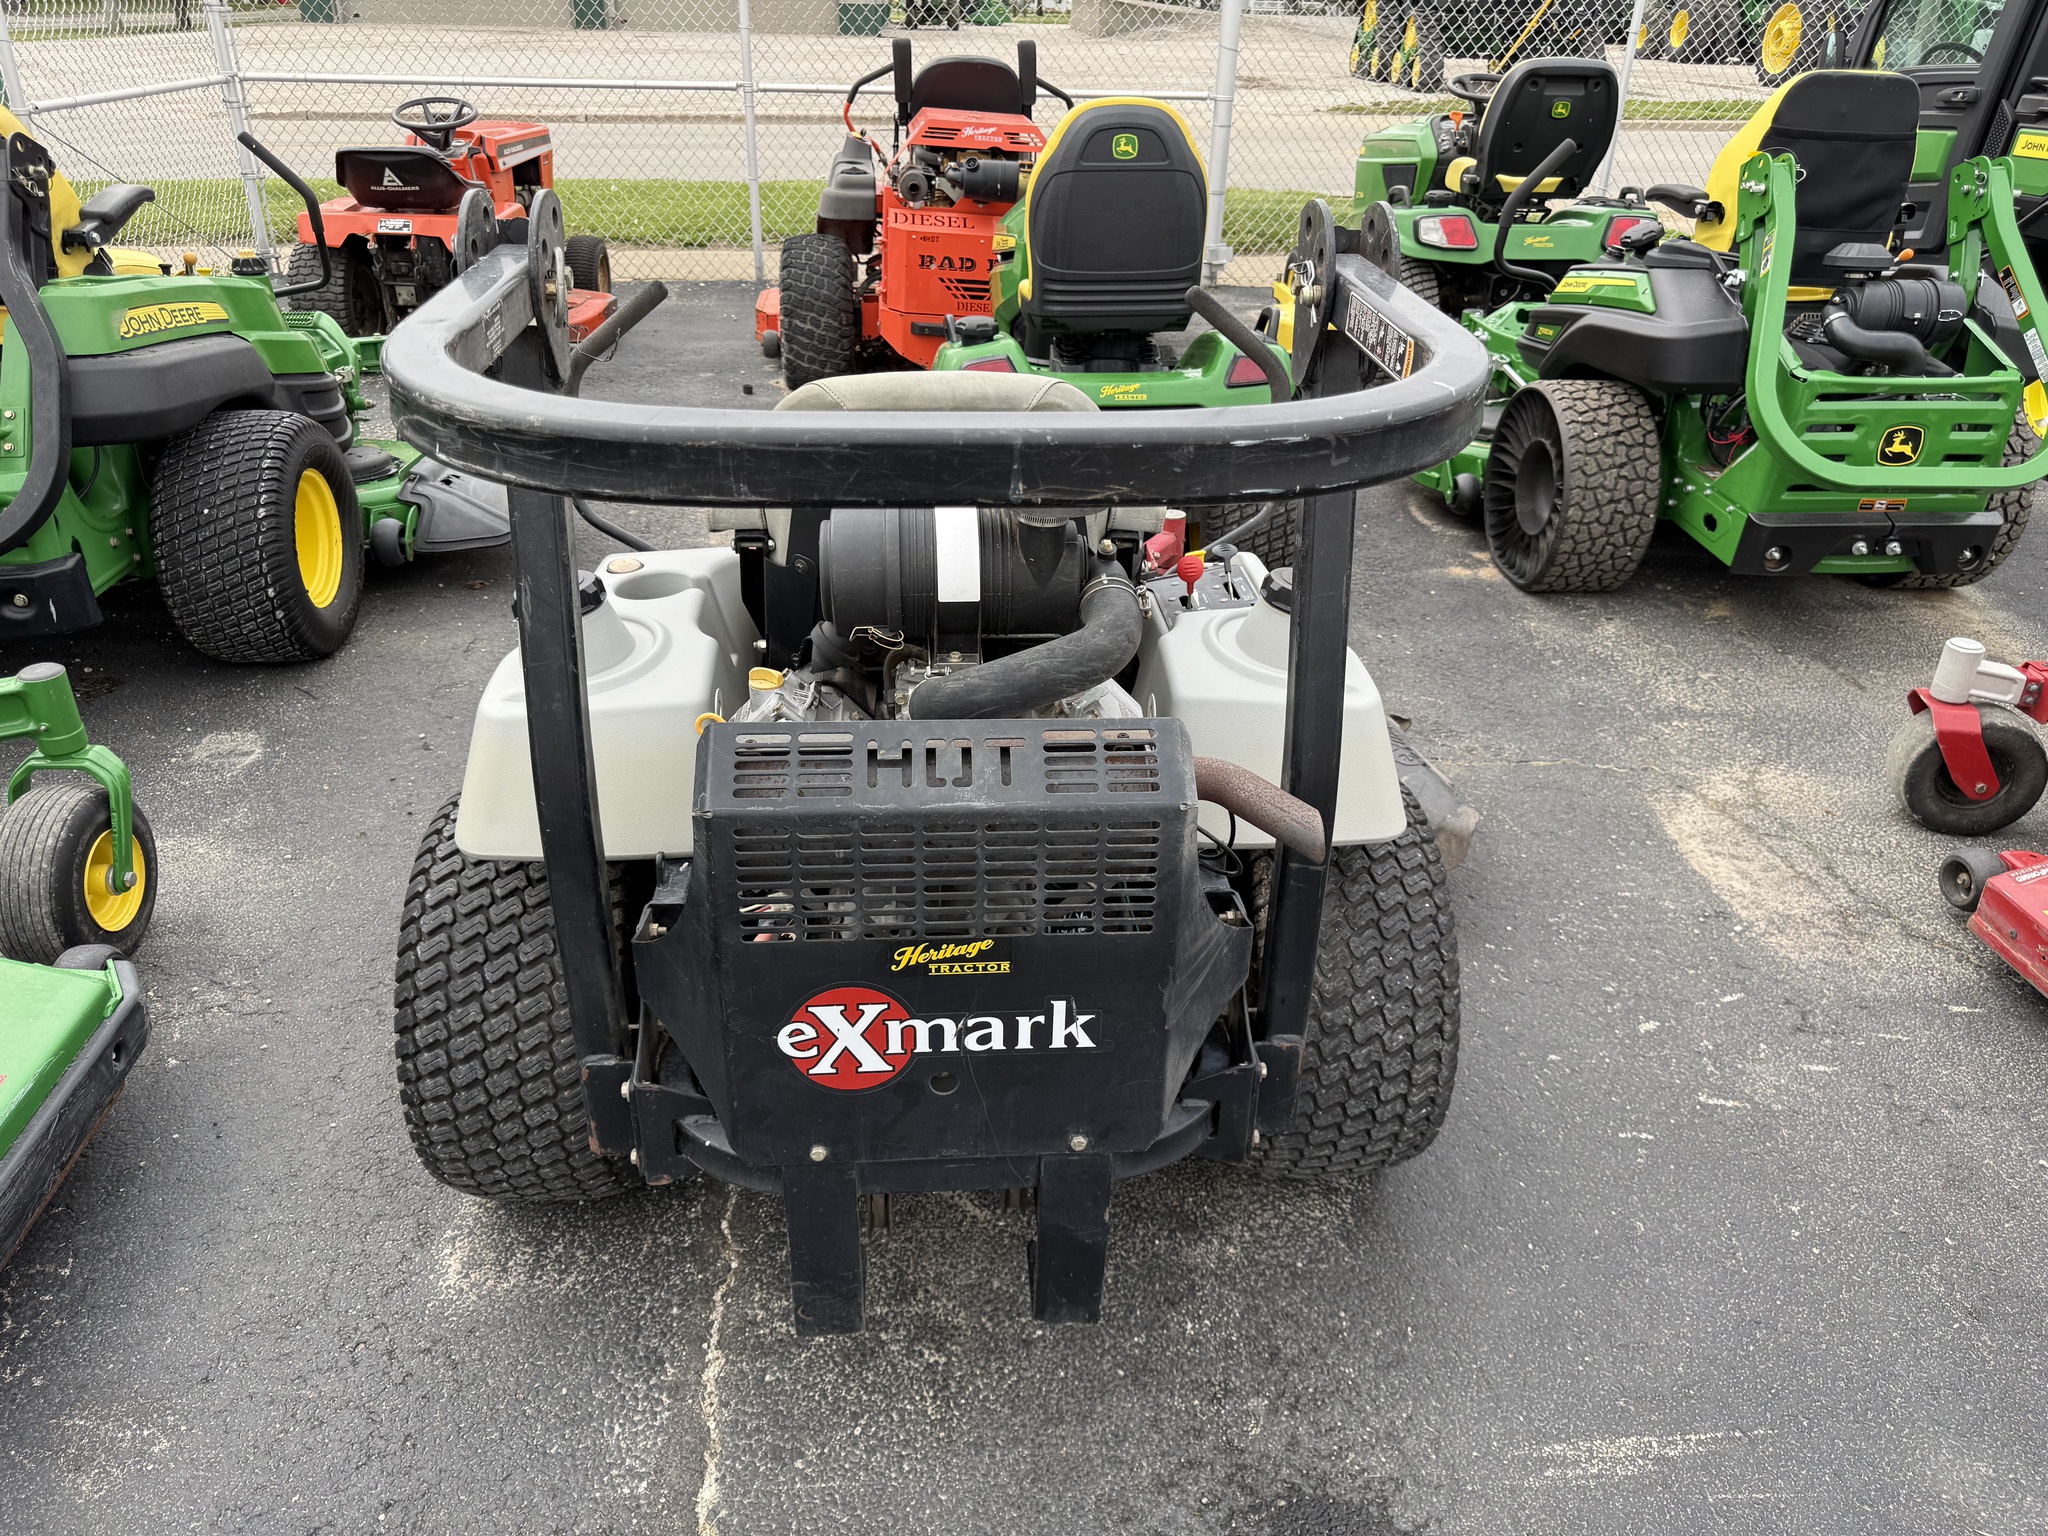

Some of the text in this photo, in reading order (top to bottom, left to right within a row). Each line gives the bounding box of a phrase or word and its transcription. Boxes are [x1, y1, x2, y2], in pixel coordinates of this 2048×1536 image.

[2021, 140, 2046, 151] JOHN
[892, 212, 975, 229] DIESEL
[918, 254, 977, 272] BAD
[122, 306, 205, 335] JOHN DEERE
[1099, 383, 1141, 399] Heritage
[866, 737, 1027, 789] HOT
[891, 939, 995, 972] Heritage
[928, 962, 1011, 974] TRACTOR
